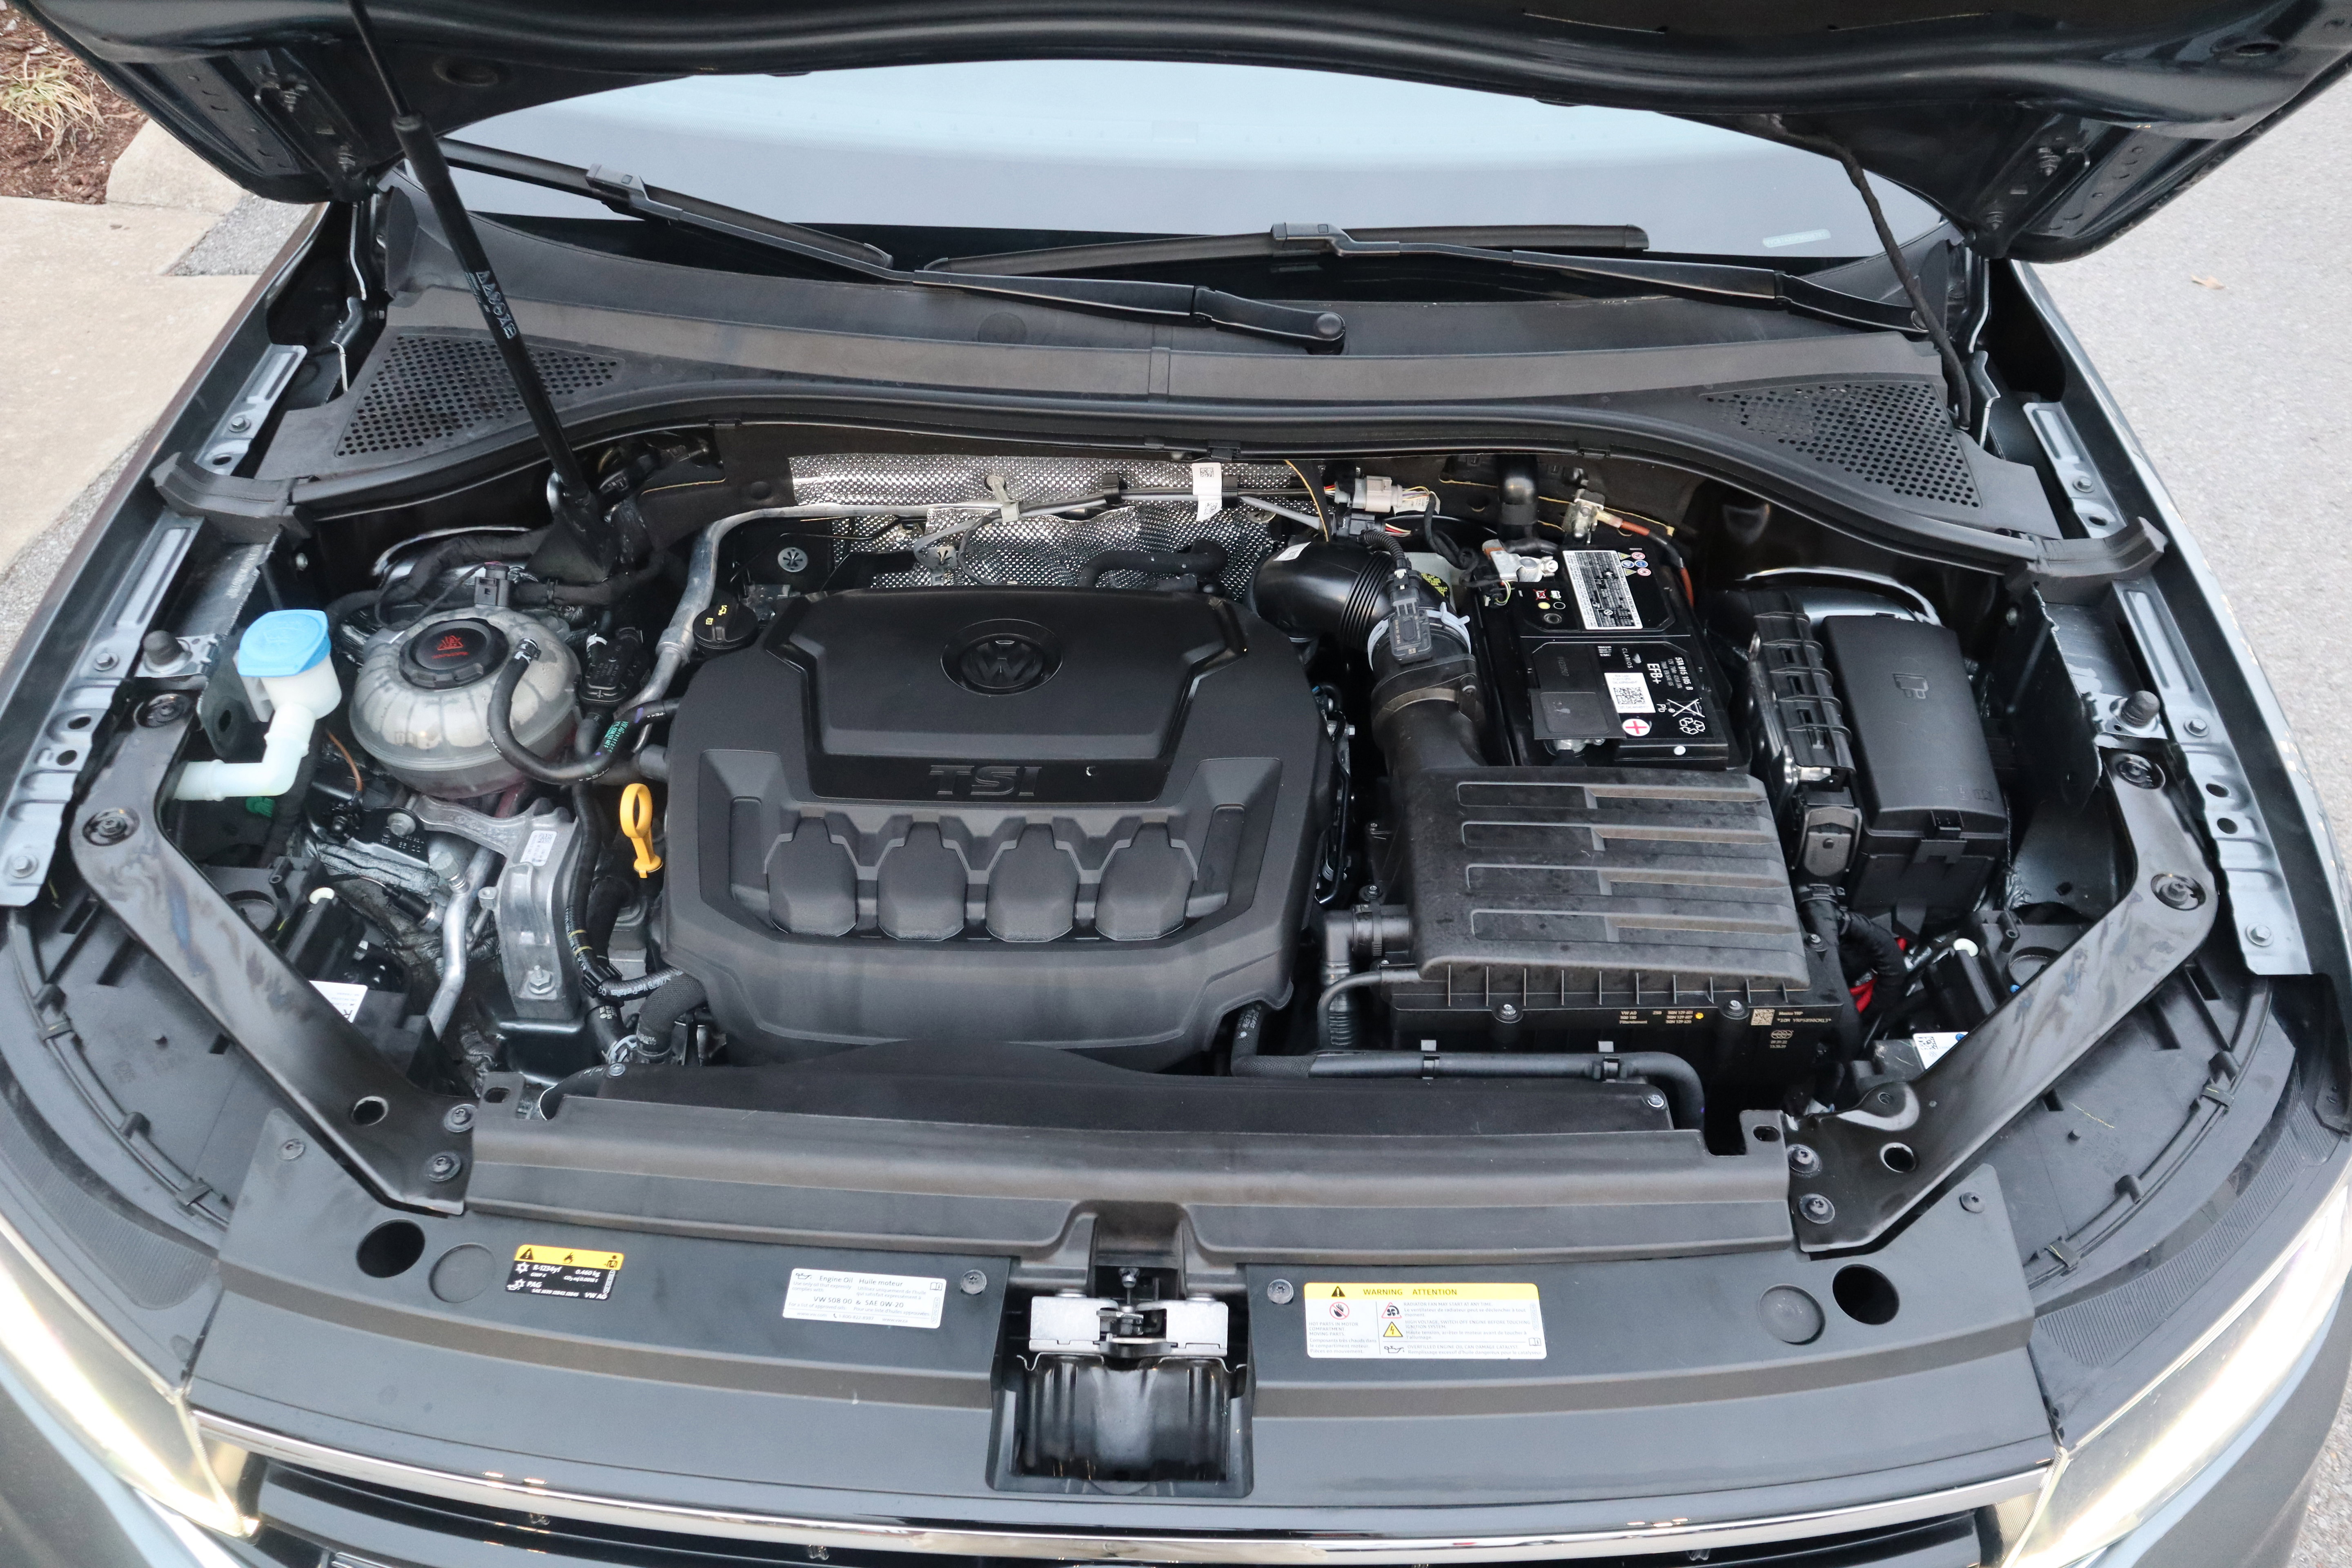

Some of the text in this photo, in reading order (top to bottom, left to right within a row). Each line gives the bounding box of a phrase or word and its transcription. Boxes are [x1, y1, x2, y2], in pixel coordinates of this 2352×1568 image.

[1621, 648, 1633, 668] CLARIOS
[1647, 663, 1663, 684] EFB+
[1679, 666, 1688, 675] 915
[1682, 676, 1691, 684] 105
[1656, 704, 1667, 713] Pb
[930, 765, 1042, 797] TSI
[532, 1265, 563, 1274] R-1234yf
